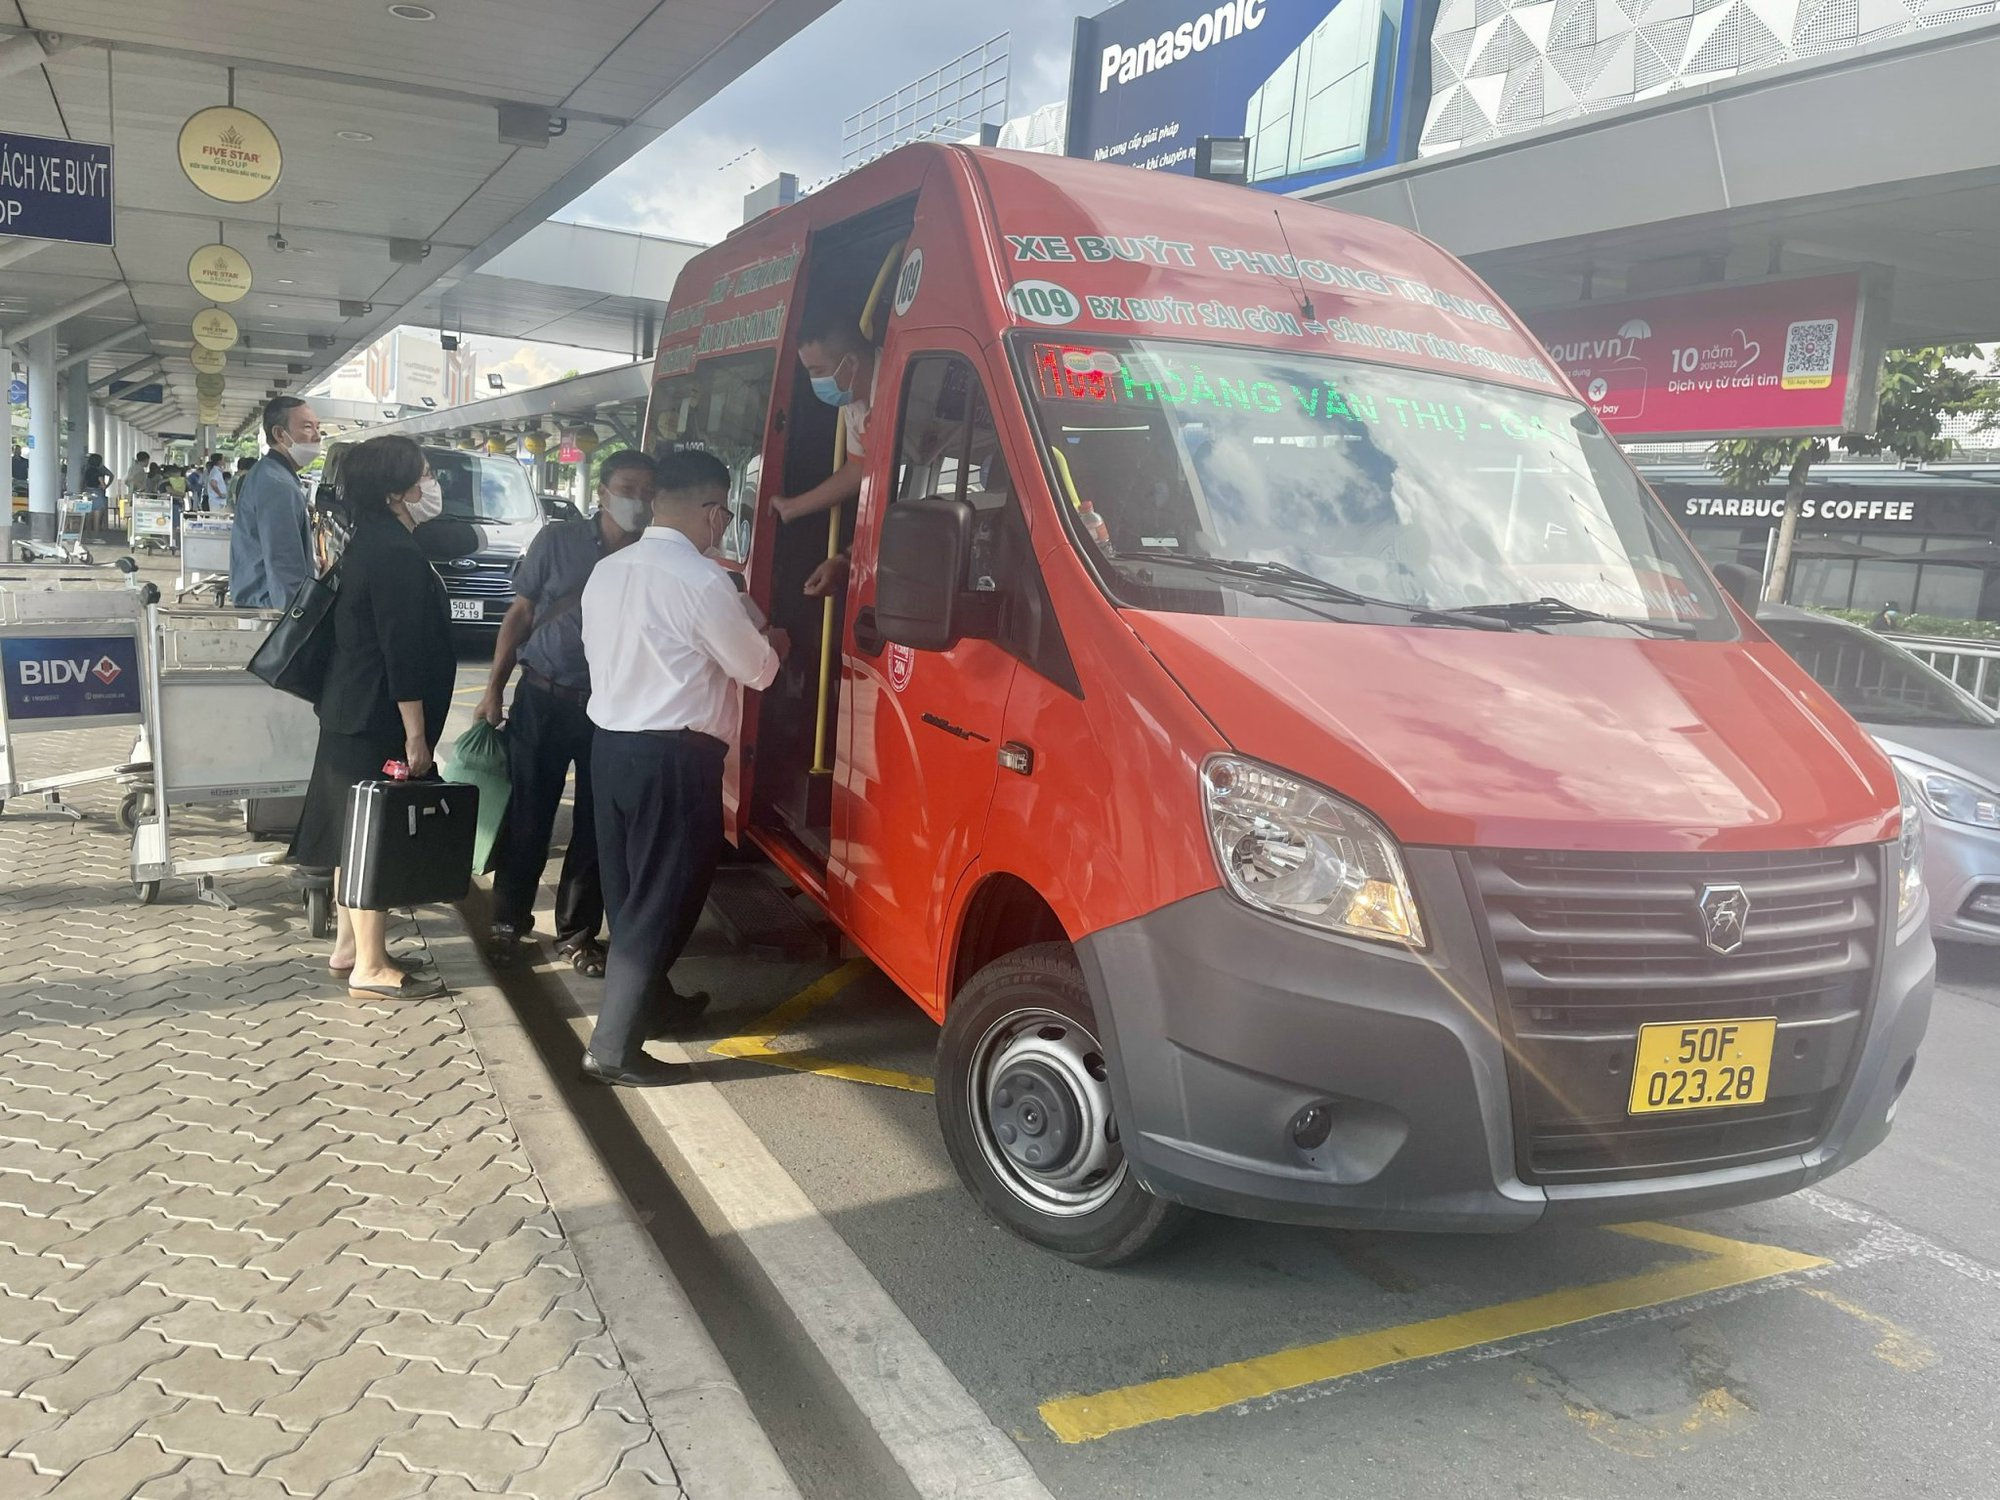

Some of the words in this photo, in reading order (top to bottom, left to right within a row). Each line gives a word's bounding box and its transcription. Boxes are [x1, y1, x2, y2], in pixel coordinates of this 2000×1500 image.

[1099, 0, 1267, 94] Panasonic
[202, 146, 228, 158] FIVE
[229, 149, 260, 163] STAR
[213, 157, 249, 168] GROUP
[1109, 142, 1127, 155] cung
[39, 156, 62, 193] XE
[65, 153, 108, 198] BUÝT
[202, 269, 218, 277] FIVE
[896, 259, 921, 305] 109
[1004, 235, 1077, 262] XE
[1074, 235, 1196, 267] BUÝT
[1208, 245, 1393, 296] PHƯƠNG
[1386, 276, 1512, 331] TRANG
[1013, 287, 1072, 318] 109
[1086, 296, 1129, 320] BX
[1125, 296, 1197, 325] BUÝT
[1198, 300, 1246, 329] SÀI
[1243, 305, 1303, 337] GÒN
[1327, 316, 1383, 349] SÂN
[1376, 327, 1424, 354] BAY
[1671, 347, 1699, 373] 10
[1702, 344, 1734, 360] năm
[1668, 379, 1696, 395] Dịch
[1698, 380, 1713, 393] vụ
[1716, 375, 1730, 389] từ
[1732, 373, 1755, 388] trái
[1757, 373, 1779, 386] tim
[1290, 380, 1380, 424] VĂN
[1386, 396, 1468, 441] THỤ
[1602, 403, 1620, 415] bay
[1685, 497, 1815, 519] STARBUCS
[1820, 500, 1915, 521] COFFEE
[19, 658, 91, 685] BIDV
[1678, 1026, 1739, 1064] 50F
[1647, 1065, 1756, 1106] 023.28
